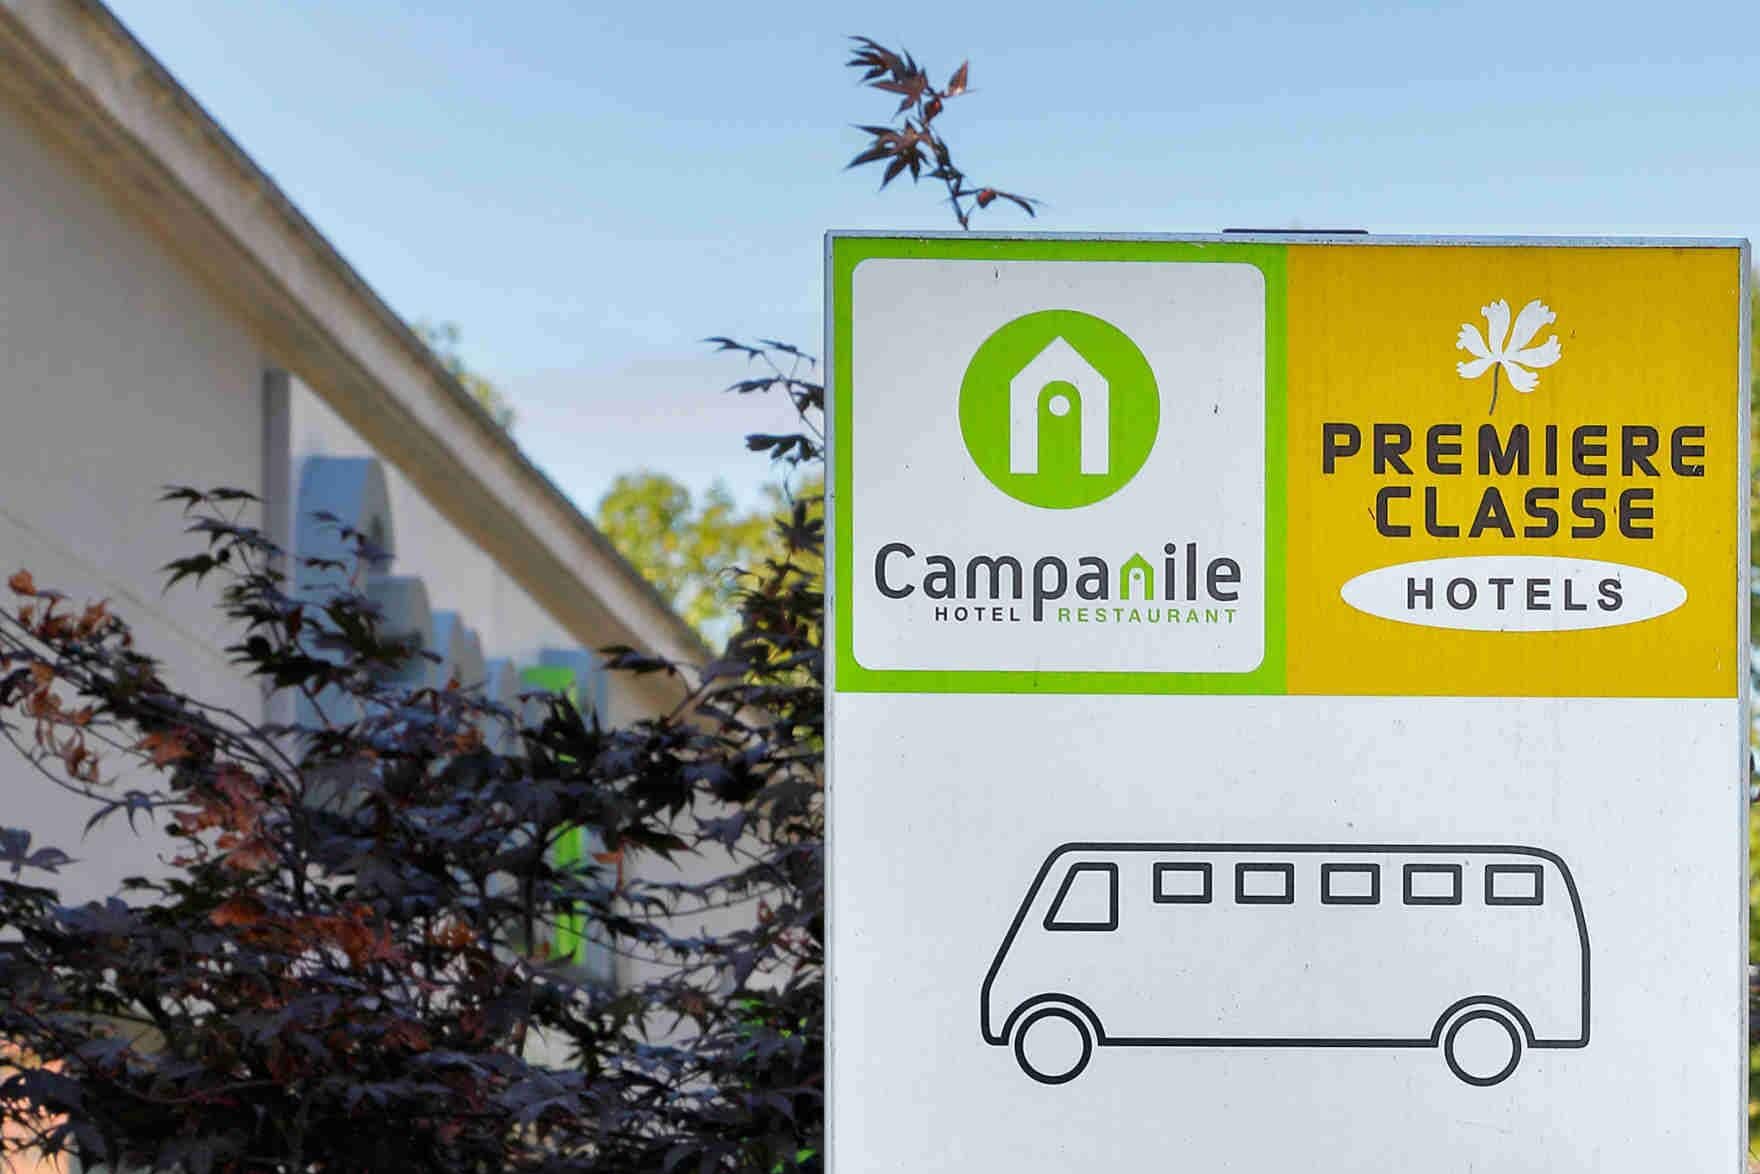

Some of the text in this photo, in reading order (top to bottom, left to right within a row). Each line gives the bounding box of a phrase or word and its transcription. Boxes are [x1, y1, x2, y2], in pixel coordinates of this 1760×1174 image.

[1322, 422, 1705, 477] PREMIERE
[1375, 486, 1654, 540] CLASSE
[874, 542, 1241, 622] Campanile
[1407, 577, 1623, 612] HOTELS
[935, 606, 1237, 623] HOTEL RESTAURANT
